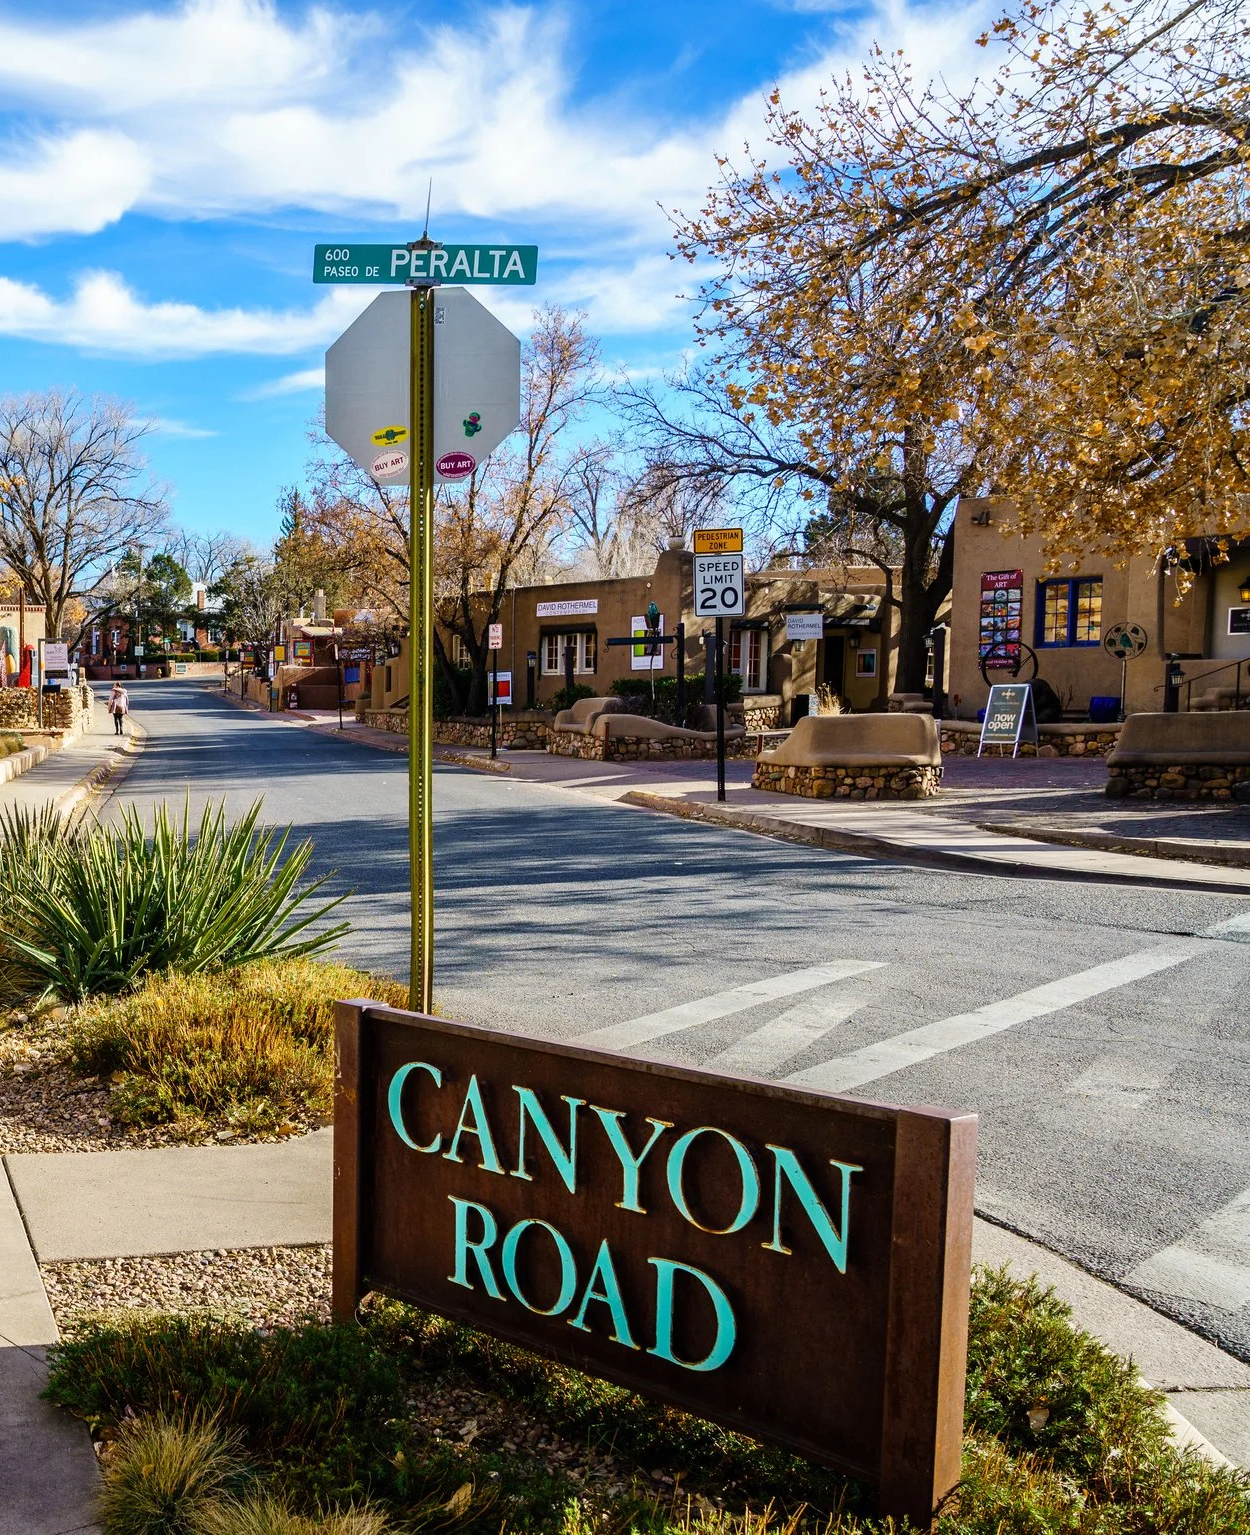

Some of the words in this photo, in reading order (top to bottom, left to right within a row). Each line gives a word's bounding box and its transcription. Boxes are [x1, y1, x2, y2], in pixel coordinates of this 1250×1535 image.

[325, 249, 350, 261] 600
[324, 266, 359, 278] PASEO
[365, 266, 380, 277] DE
[390, 249, 526, 279] PERALTA
[375, 462, 388, 471] BUY
[391, 457, 404, 466] ART
[440, 462, 455, 470] BUY
[697, 531, 739, 541] PEDESTRIAN
[709, 542, 728, 550] ZONE
[698, 561, 739, 573] SPEED
[703, 574, 735, 585] LIMIT
[986, 574, 998, 582] The
[998, 573, 1010, 581] Gift
[1010, 572, 1018, 580] of
[699, 586, 739, 610] 20
[537, 603, 556, 612] DAVID
[557, 600, 597, 610] ROTHERMEL
[993, 713, 1016, 722] now
[988, 721, 1014, 732] open
[386, 1060, 865, 1275] CANYON
[446, 1193, 737, 1373] ROAD
